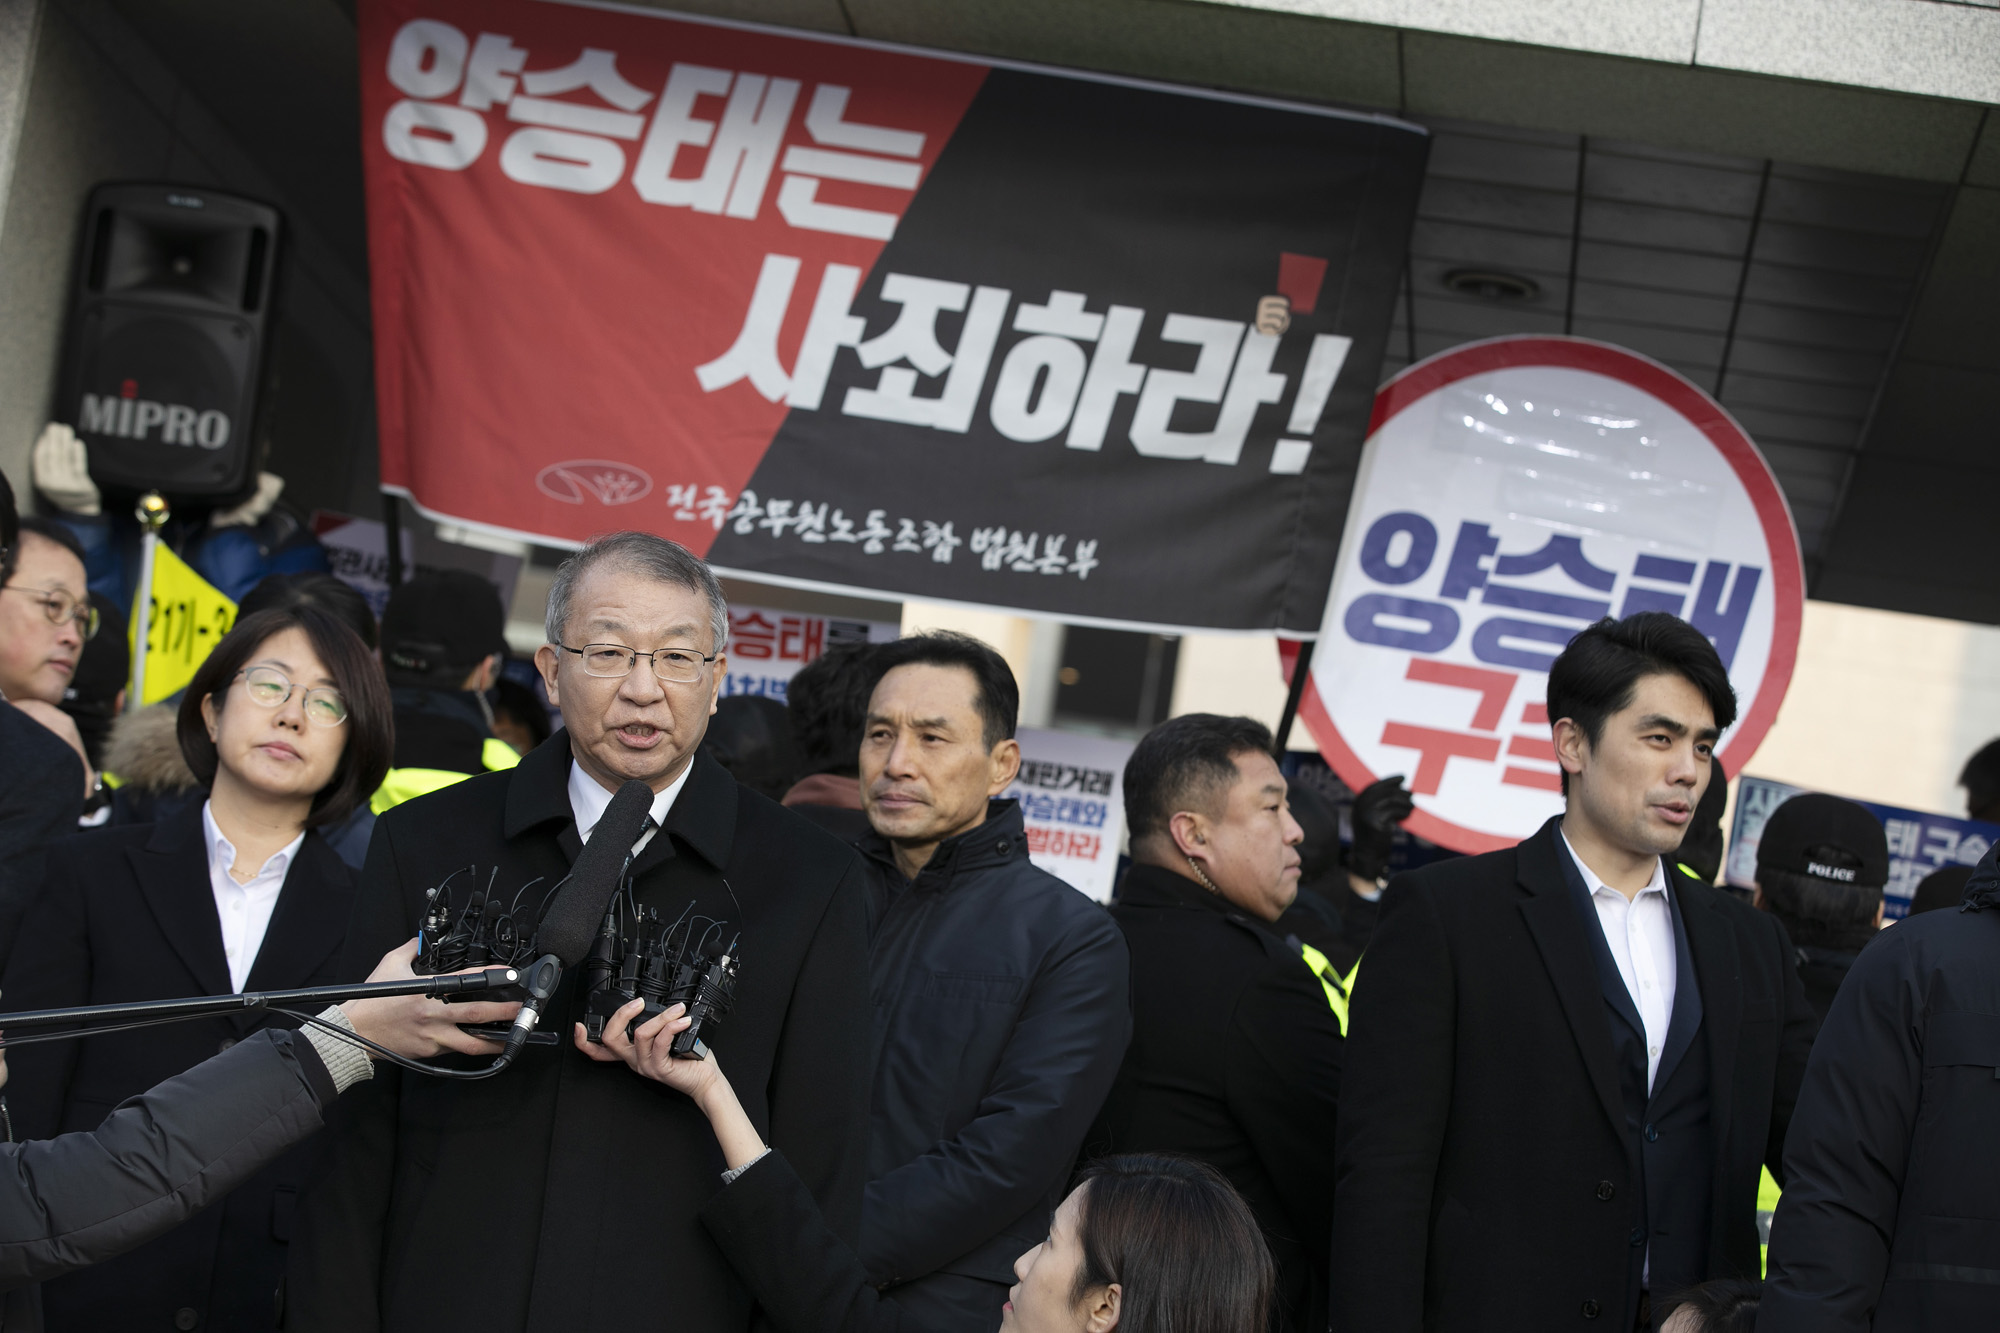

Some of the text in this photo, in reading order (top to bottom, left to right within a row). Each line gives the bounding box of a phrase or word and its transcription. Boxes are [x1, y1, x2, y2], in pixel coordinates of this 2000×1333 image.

[383, 18, 926, 241] 양승태는
[696, 253, 1353, 475] 사죄하라!
[666, 483, 1099, 580] 전국공무원노동조합 법원본부
[1343, 511, 1763, 680] 양승태
[726, 609, 869, 664] 승태
[1807, 861, 1856, 882] POLICE
